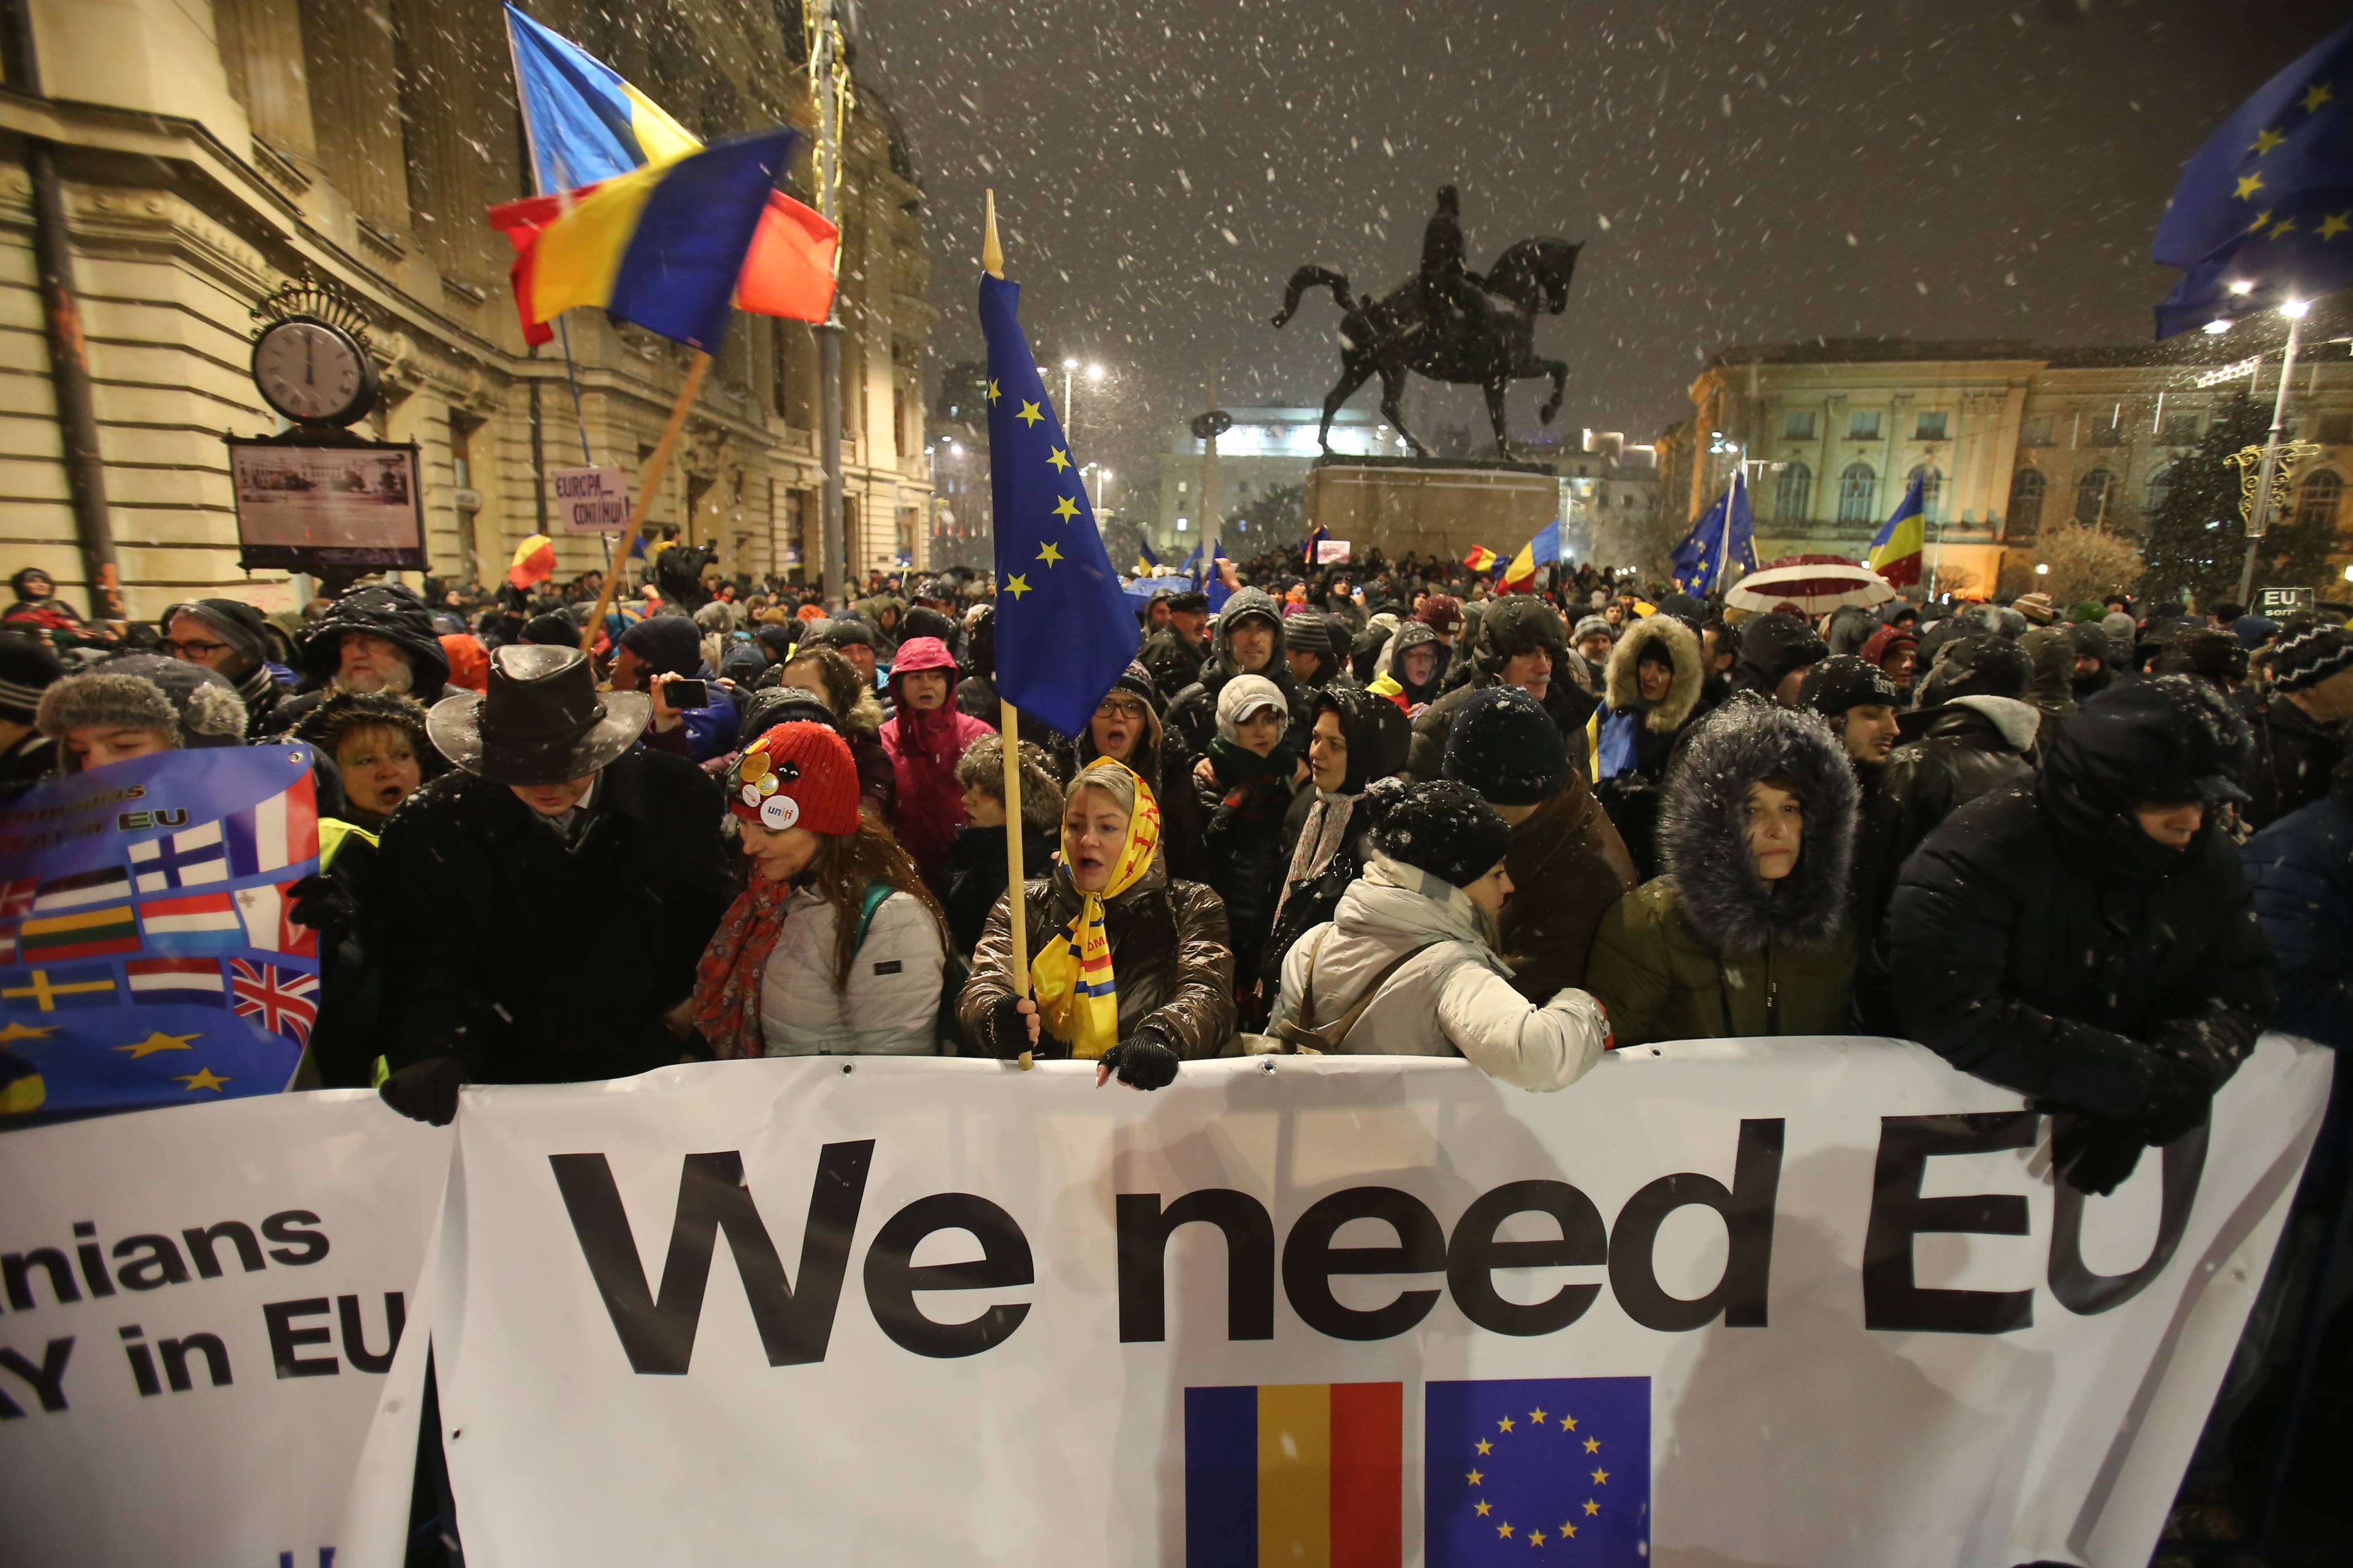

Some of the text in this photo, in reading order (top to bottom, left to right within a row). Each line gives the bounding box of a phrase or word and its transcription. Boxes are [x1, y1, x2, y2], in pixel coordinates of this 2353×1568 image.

[2264, 591, 2302, 607] EU,
[117, 808, 188, 831] EU
[0, 1210, 330, 1315] nians
[549, 1110, 2213, 1375] We need EU
[118, 1324, 234, 1397] in
[263, 1292, 406, 1380] EU
